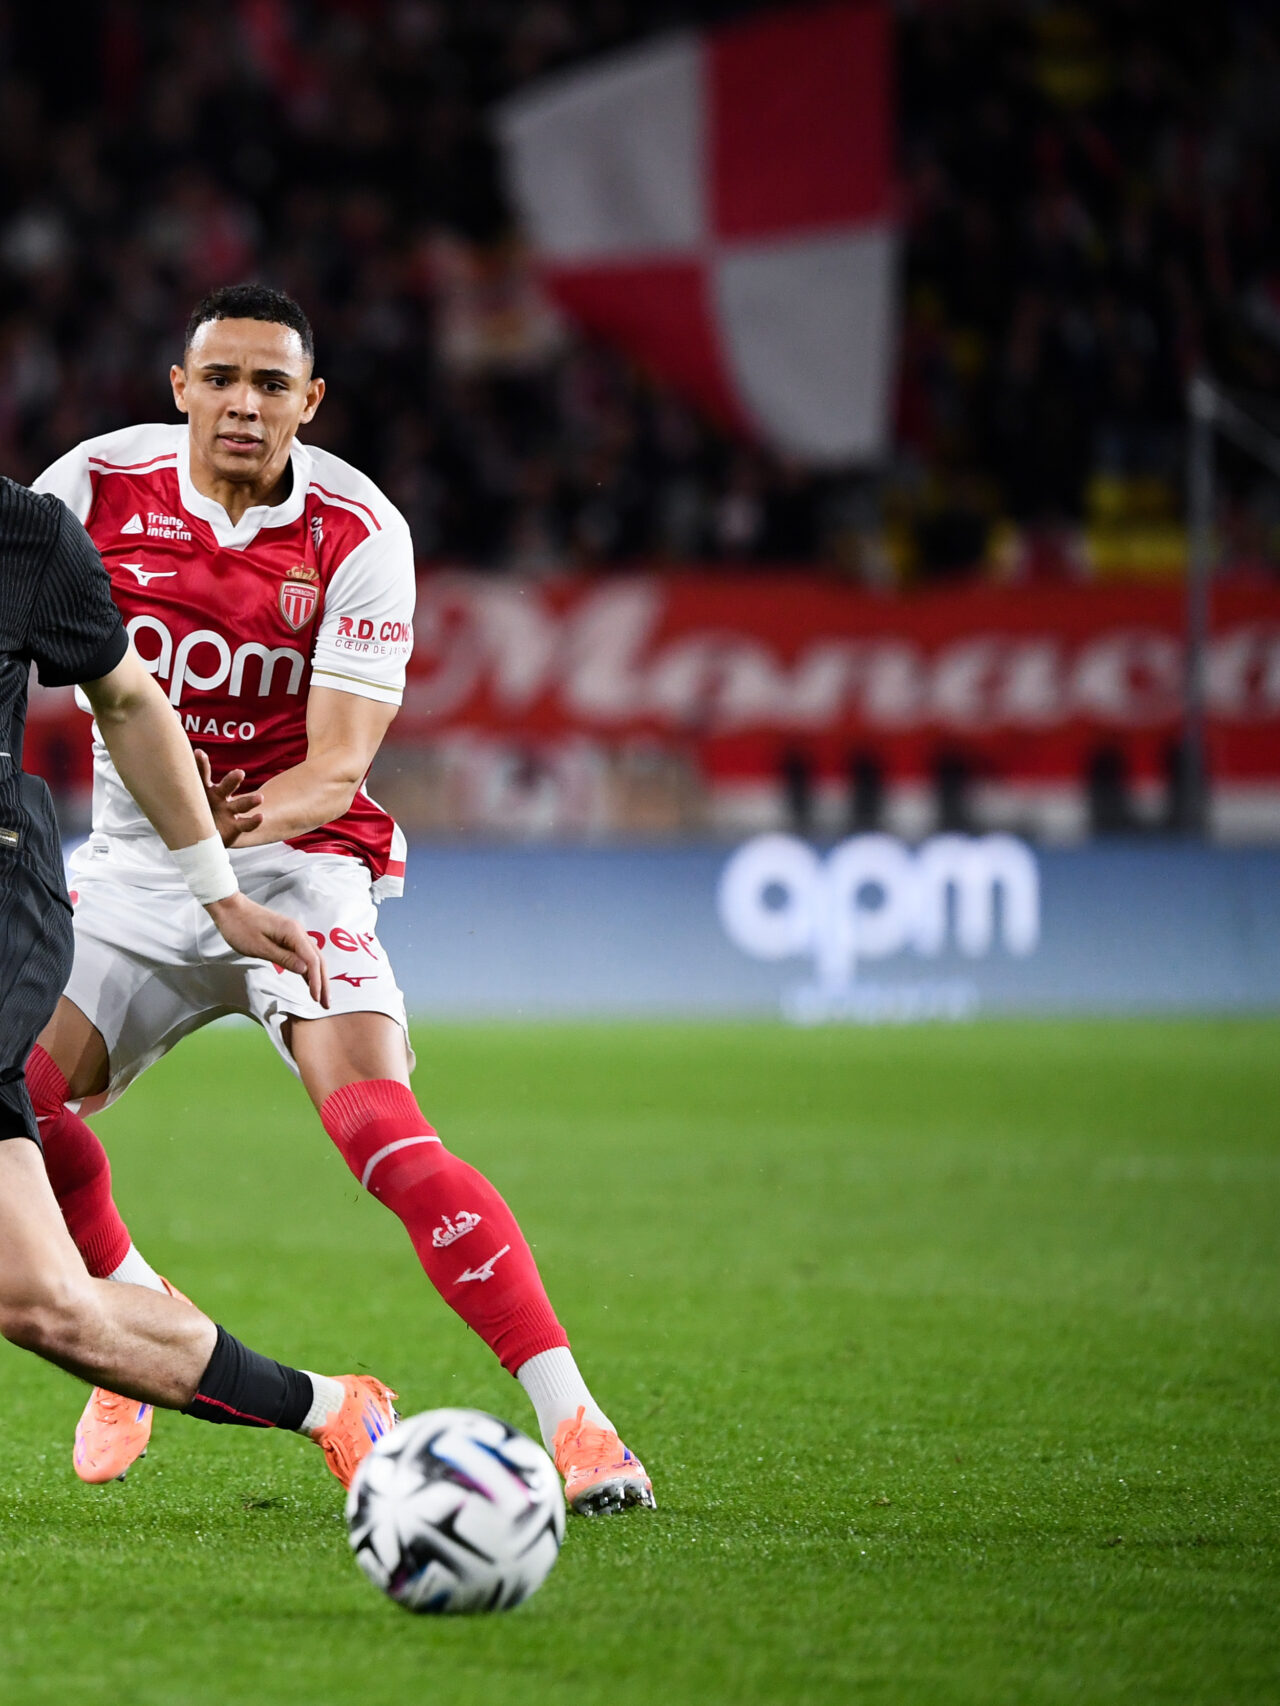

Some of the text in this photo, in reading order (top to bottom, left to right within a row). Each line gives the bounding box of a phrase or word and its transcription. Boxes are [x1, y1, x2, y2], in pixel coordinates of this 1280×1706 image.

[146, 525, 192, 541] intérim
[337, 616, 375, 641] R.D.
[123, 615, 305, 707] apm
[373, 645, 386, 655] DE
[720, 833, 1042, 990] apm
